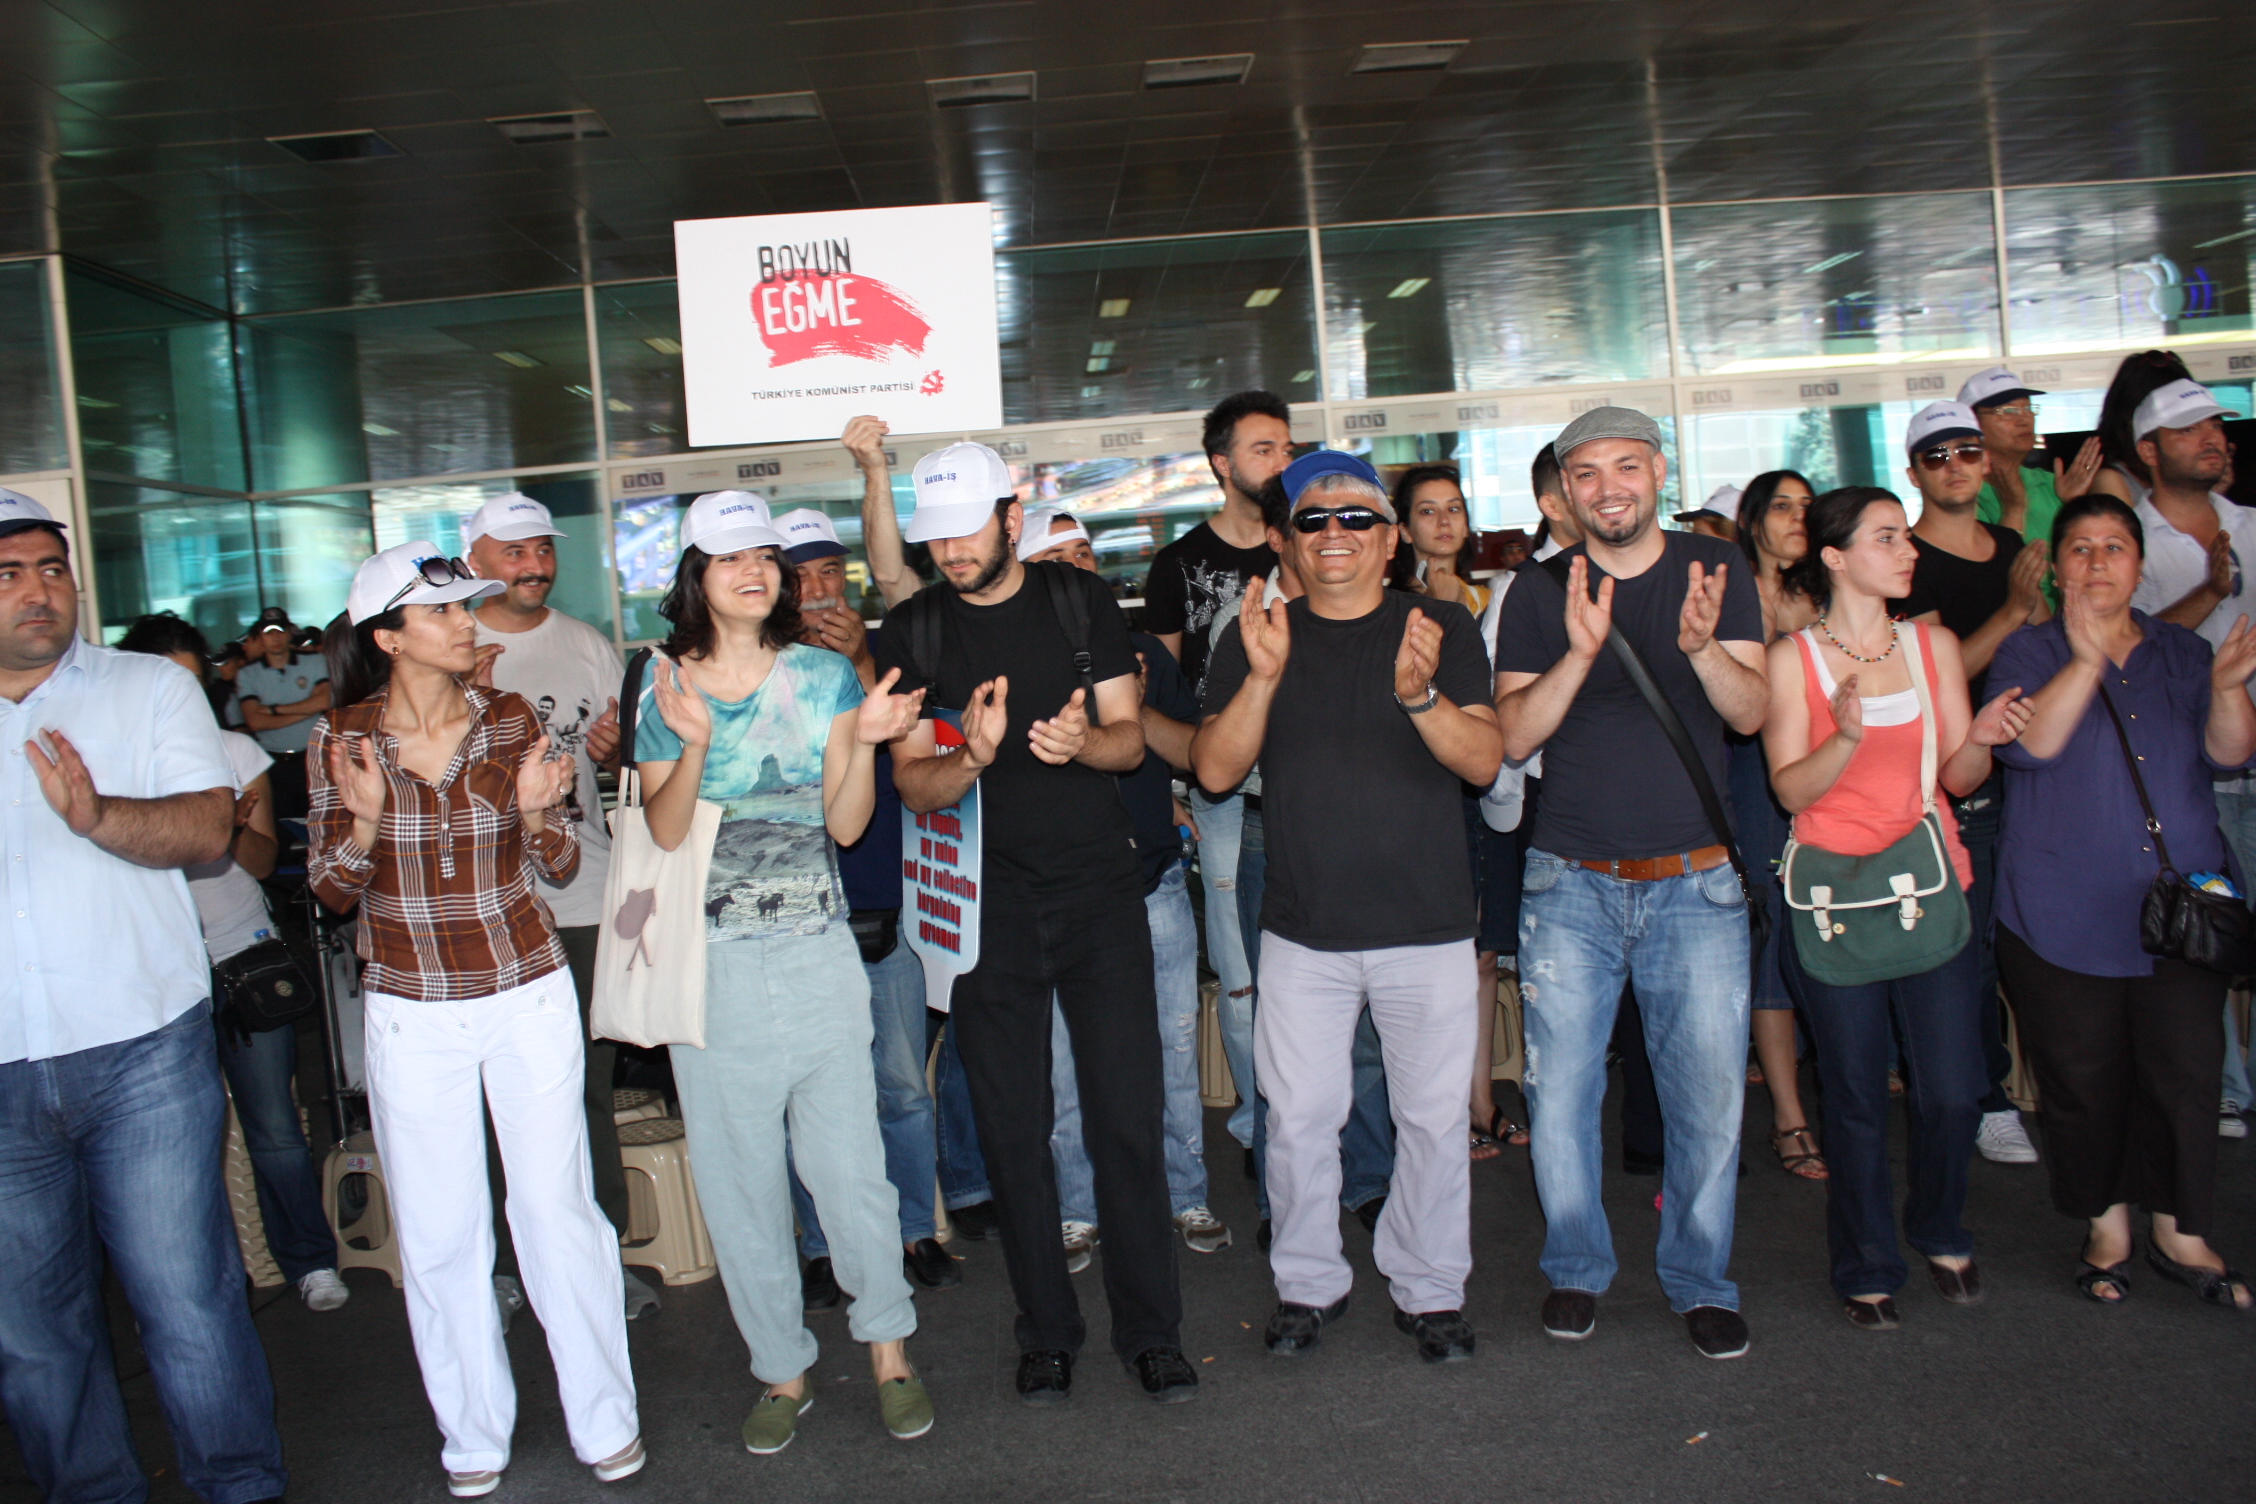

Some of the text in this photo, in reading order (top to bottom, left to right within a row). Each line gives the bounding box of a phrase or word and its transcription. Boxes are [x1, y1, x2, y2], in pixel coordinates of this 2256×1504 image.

[757, 237, 851, 284] BOYUN
[762, 279, 862, 335] EĞME
[751, 381, 914, 400] TÜRKİYE KOMÜNİST PARTİSİ
[622, 472, 665, 488] TAV
[738, 462, 781, 478] TAV
[921, 837, 958, 867] my union
[904, 859, 976, 901] and my collective
[917, 888, 961, 929] bargaining
[919, 919, 960, 954] agreement
